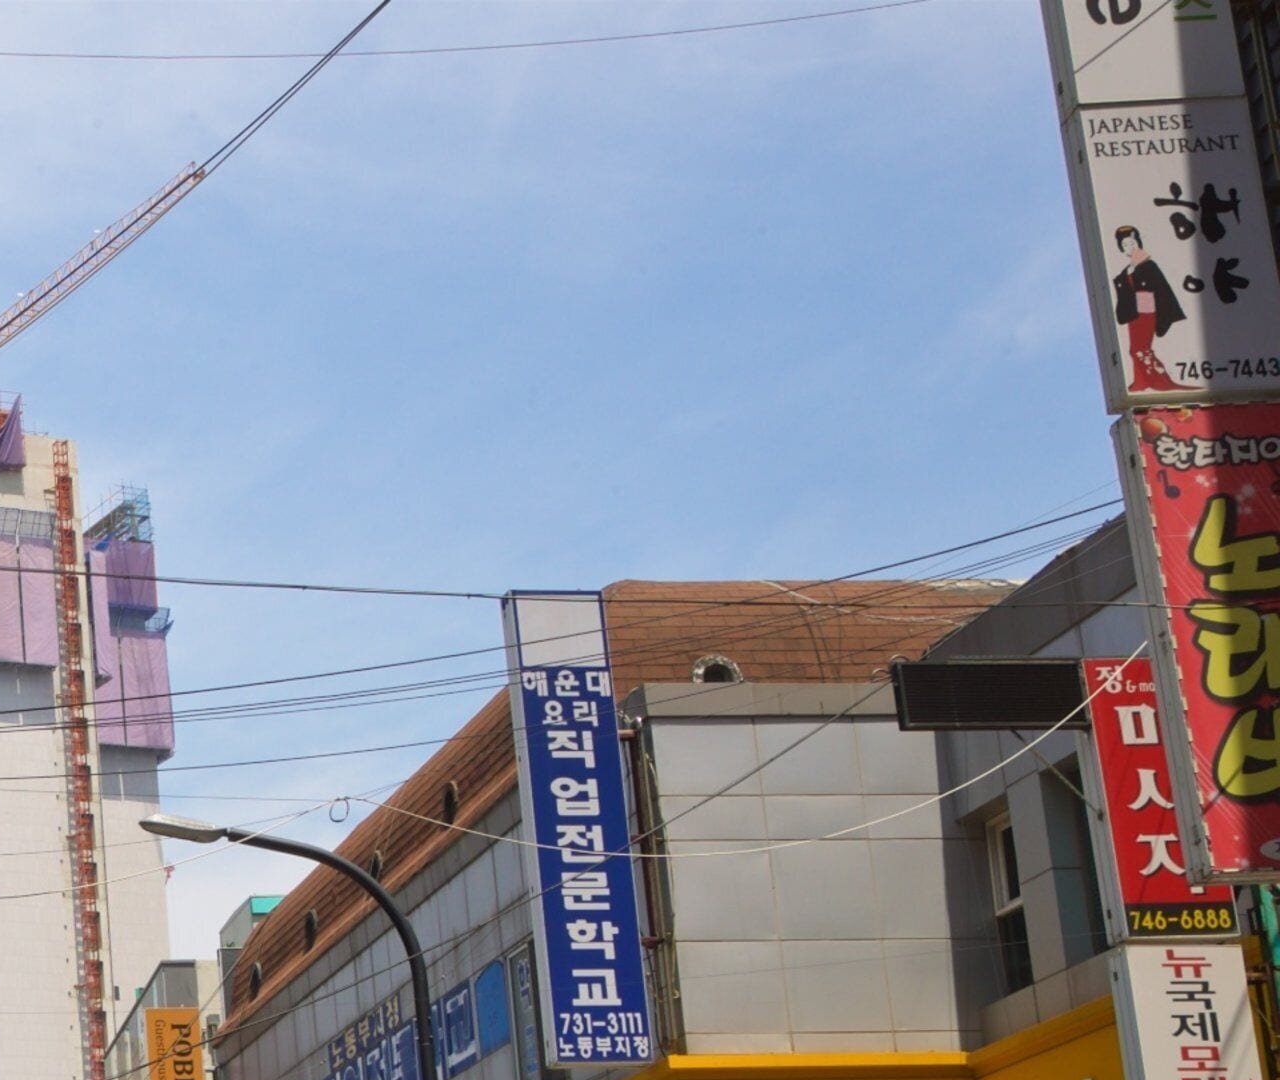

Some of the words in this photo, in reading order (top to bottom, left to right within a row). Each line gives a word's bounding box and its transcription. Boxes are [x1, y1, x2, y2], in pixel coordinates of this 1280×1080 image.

[1088, 112, 1195, 138] JAPANESE
[1093, 133, 1241, 158] RESTAURANT
[1175, 357, 1280, 381] 746-7443
[522, 668, 611, 699] 해운대
[1095, 665, 1124, 694] 정
[542, 700, 599, 728] 요리
[545, 728, 623, 1008] 직업전문학교
[1129, 908, 1232, 931] 746-6888
[330, 995, 400, 1069] 노동부지정
[558, 1012, 643, 1036] 731-3111
[558, 1035, 650, 1059] 노동부지정
